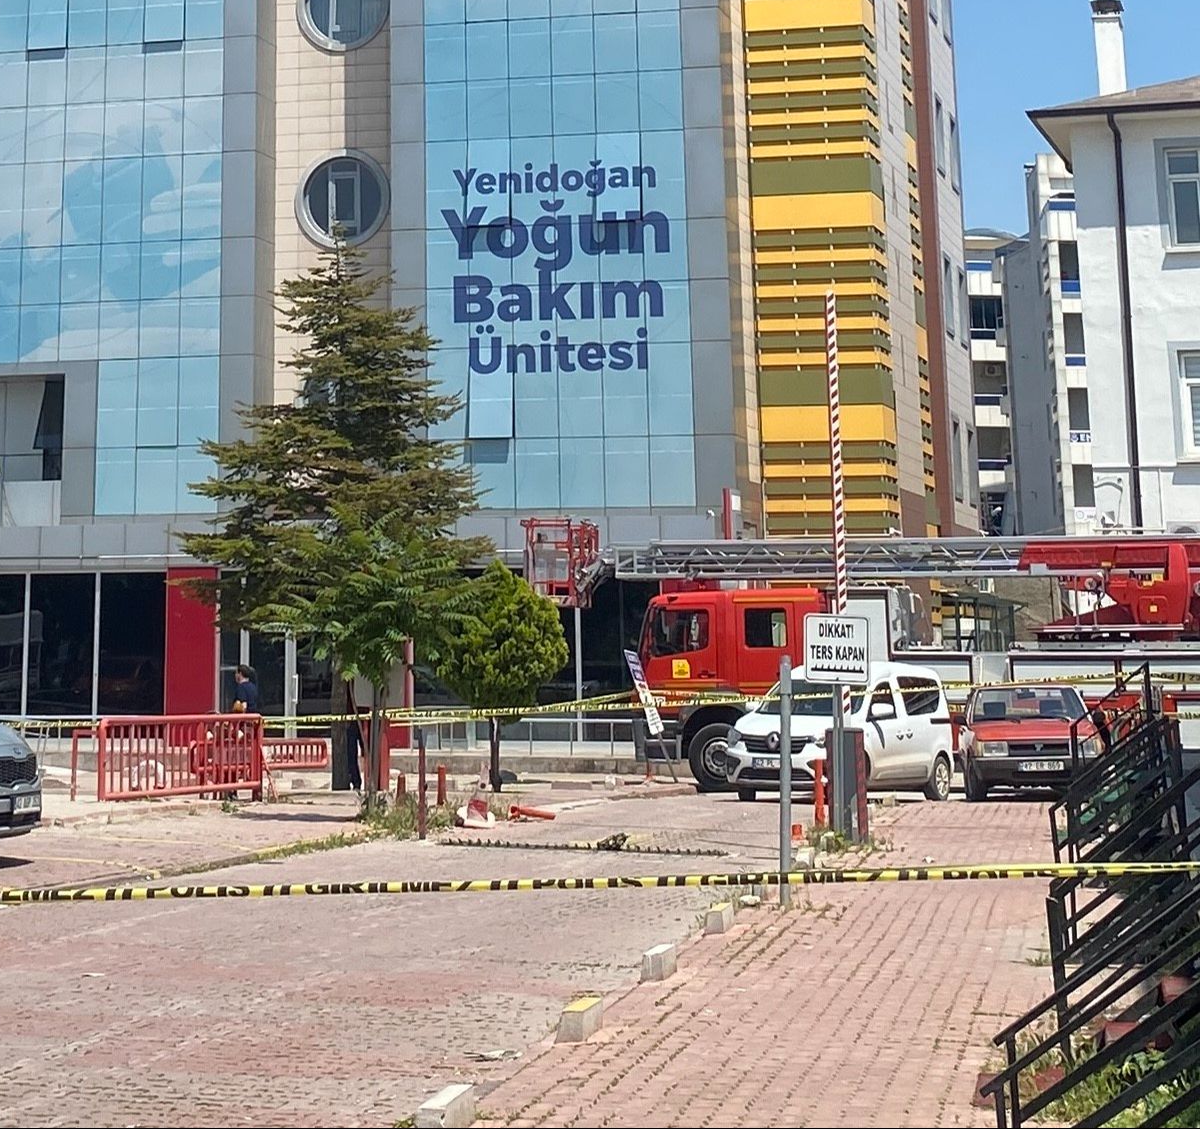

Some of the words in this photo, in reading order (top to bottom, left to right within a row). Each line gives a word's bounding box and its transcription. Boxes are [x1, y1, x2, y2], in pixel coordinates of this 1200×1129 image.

[452, 160, 657, 198] Yenidoğan
[440, 199, 671, 272] Yoğun
[453, 270, 664, 323] Bakım
[469, 324, 648, 375] Ünitesi
[810, 645, 833, 660] TERS
[835, 646, 865, 661] KAPAN
